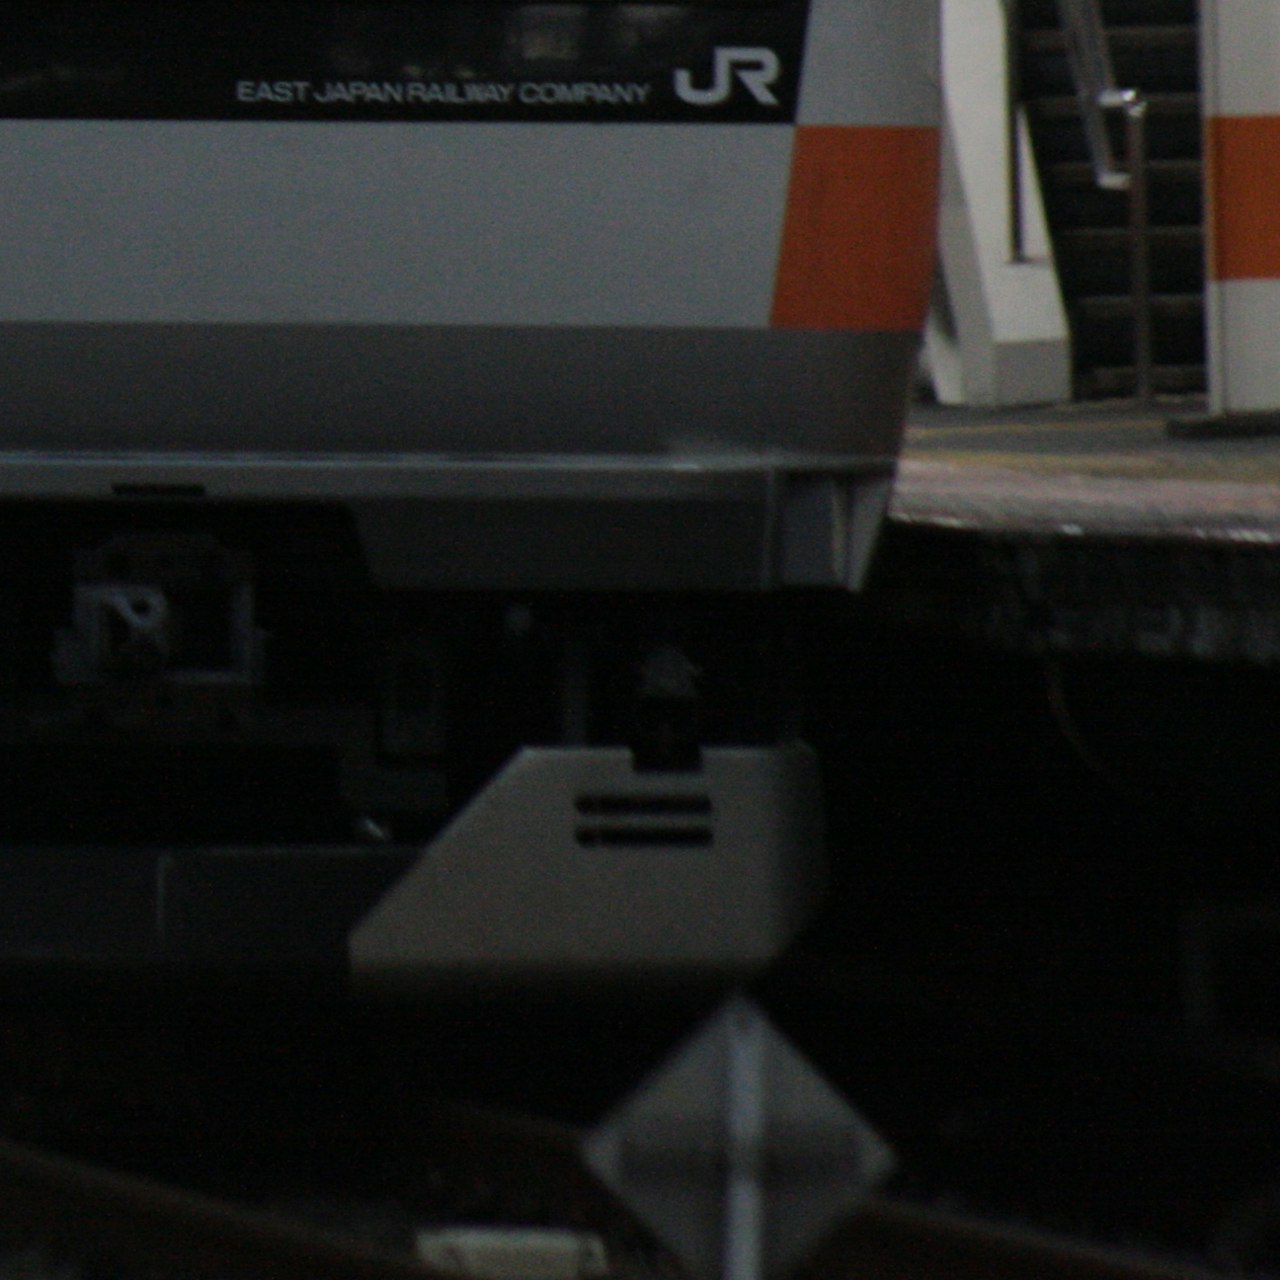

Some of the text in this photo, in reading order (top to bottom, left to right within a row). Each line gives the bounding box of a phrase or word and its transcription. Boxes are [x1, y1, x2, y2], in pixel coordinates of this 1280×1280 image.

[237, 79, 652, 106] EAST JAPAN RAILWAY COMPANY
[672, 45, 781, 108] JR
